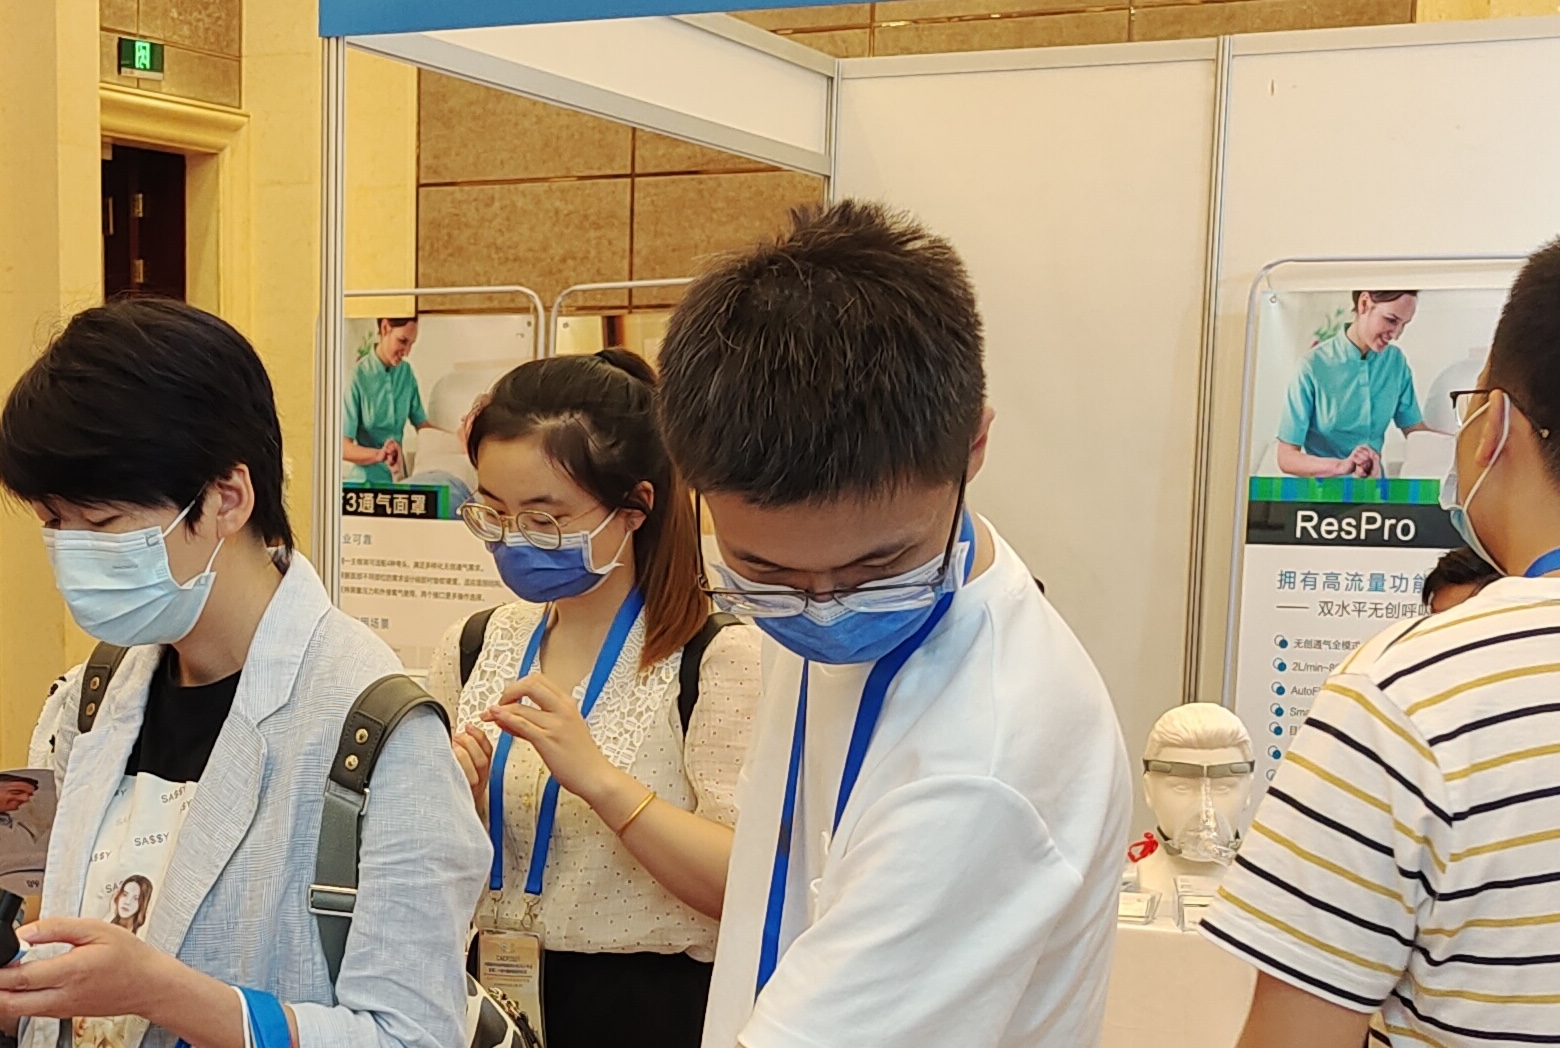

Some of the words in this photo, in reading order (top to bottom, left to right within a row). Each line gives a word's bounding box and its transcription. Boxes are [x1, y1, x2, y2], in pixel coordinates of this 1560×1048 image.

[342, 492, 427, 516] 3通气面罩
[1294, 510, 1417, 542] ResPro
[1277, 569, 1426, 594] 拥有高流量功能
[1318, 600, 1431, 619] 双水平无创呼吸
[354, 615, 389, 630] 用场景
